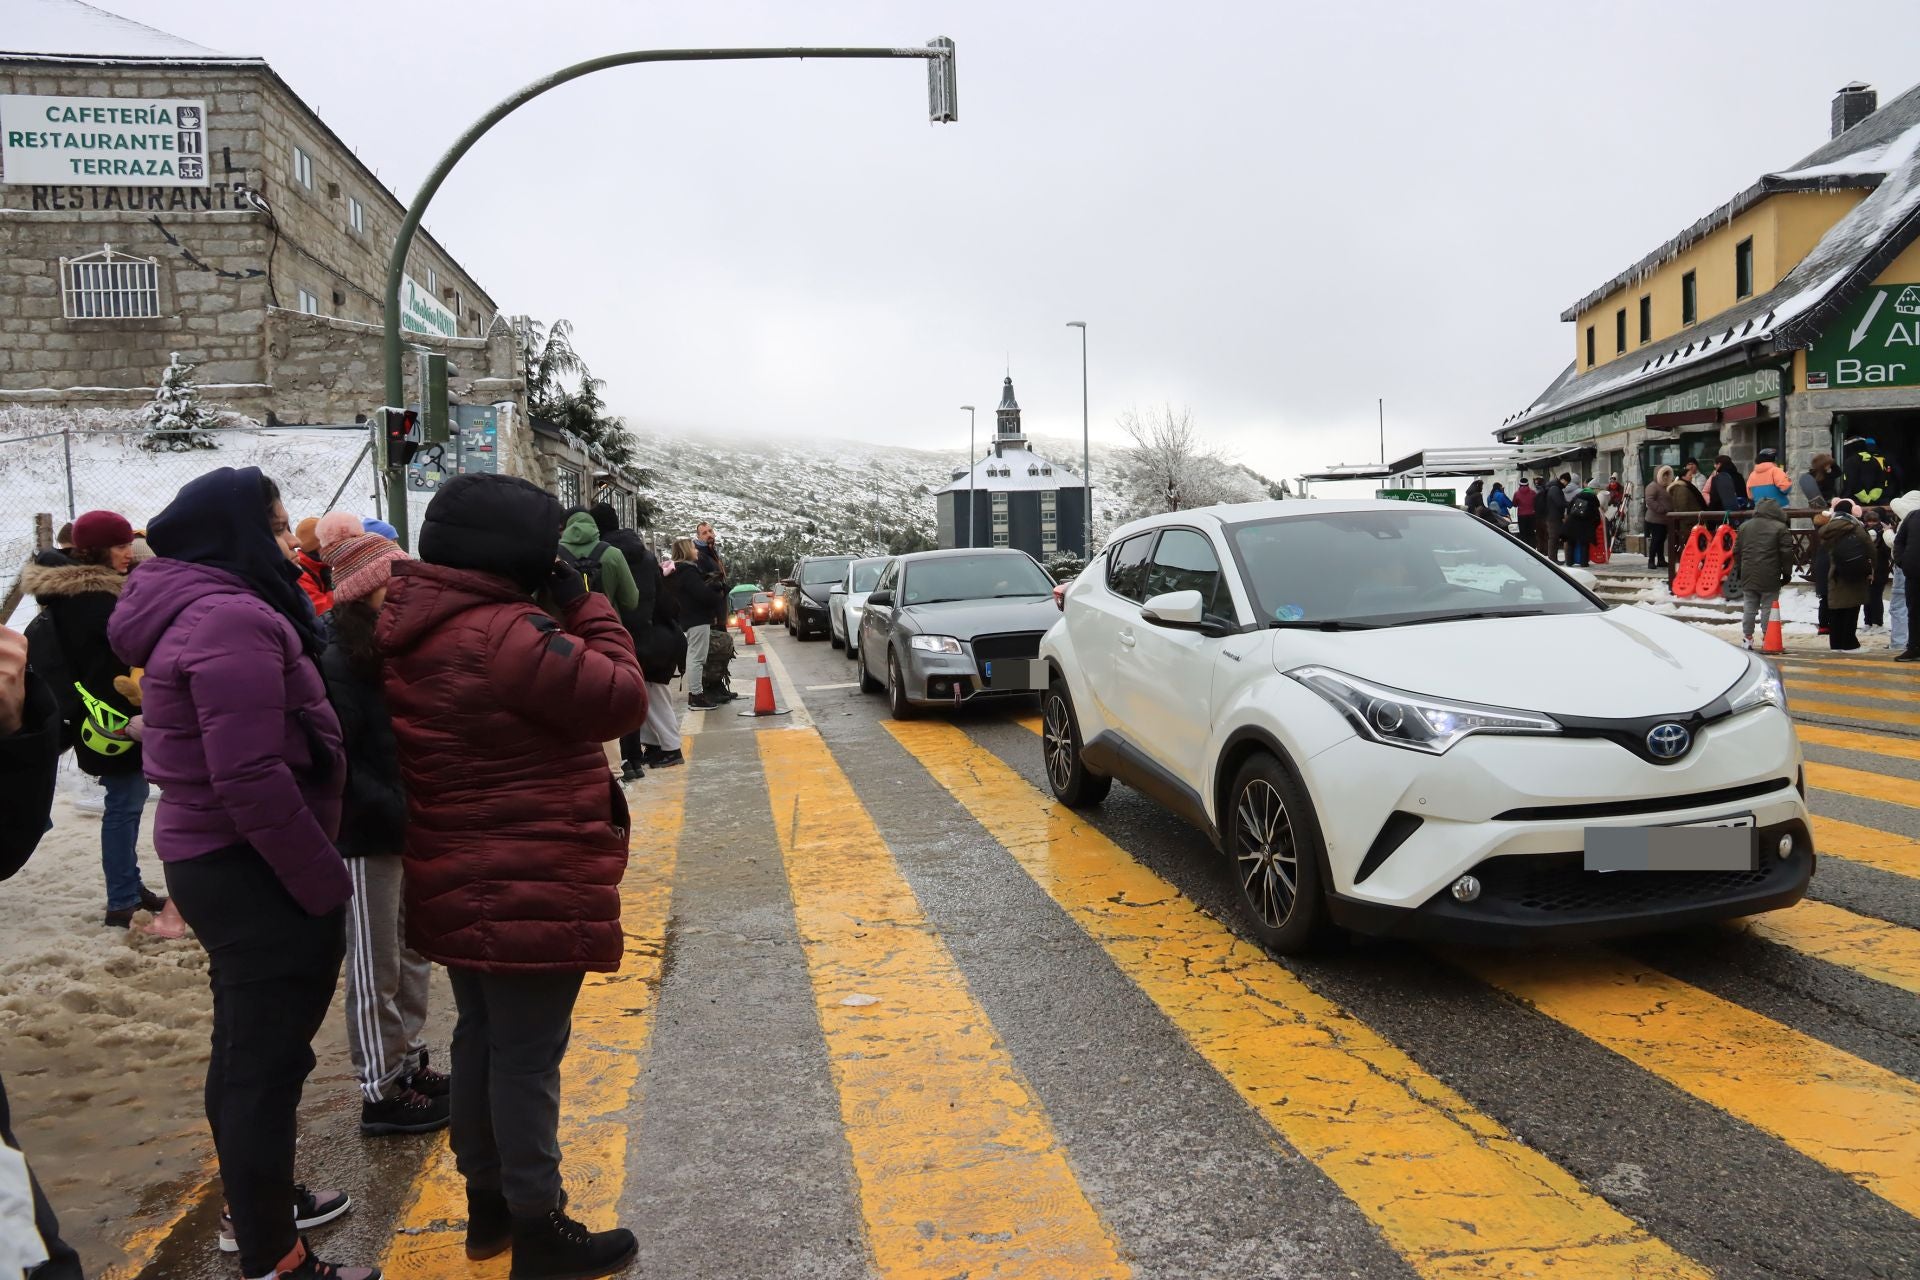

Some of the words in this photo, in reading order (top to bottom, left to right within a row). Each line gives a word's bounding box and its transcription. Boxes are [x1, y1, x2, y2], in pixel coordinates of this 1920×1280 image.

[46, 104, 174, 125] CAFETERÍA
[8, 131, 174, 151] RESTAURANTE
[70, 158, 175, 176] TERRAZA
[32, 182, 249, 211] RESTAURANTE
[1836, 359, 1906, 384] Bar
[1666, 389, 1700, 413] Tienda
